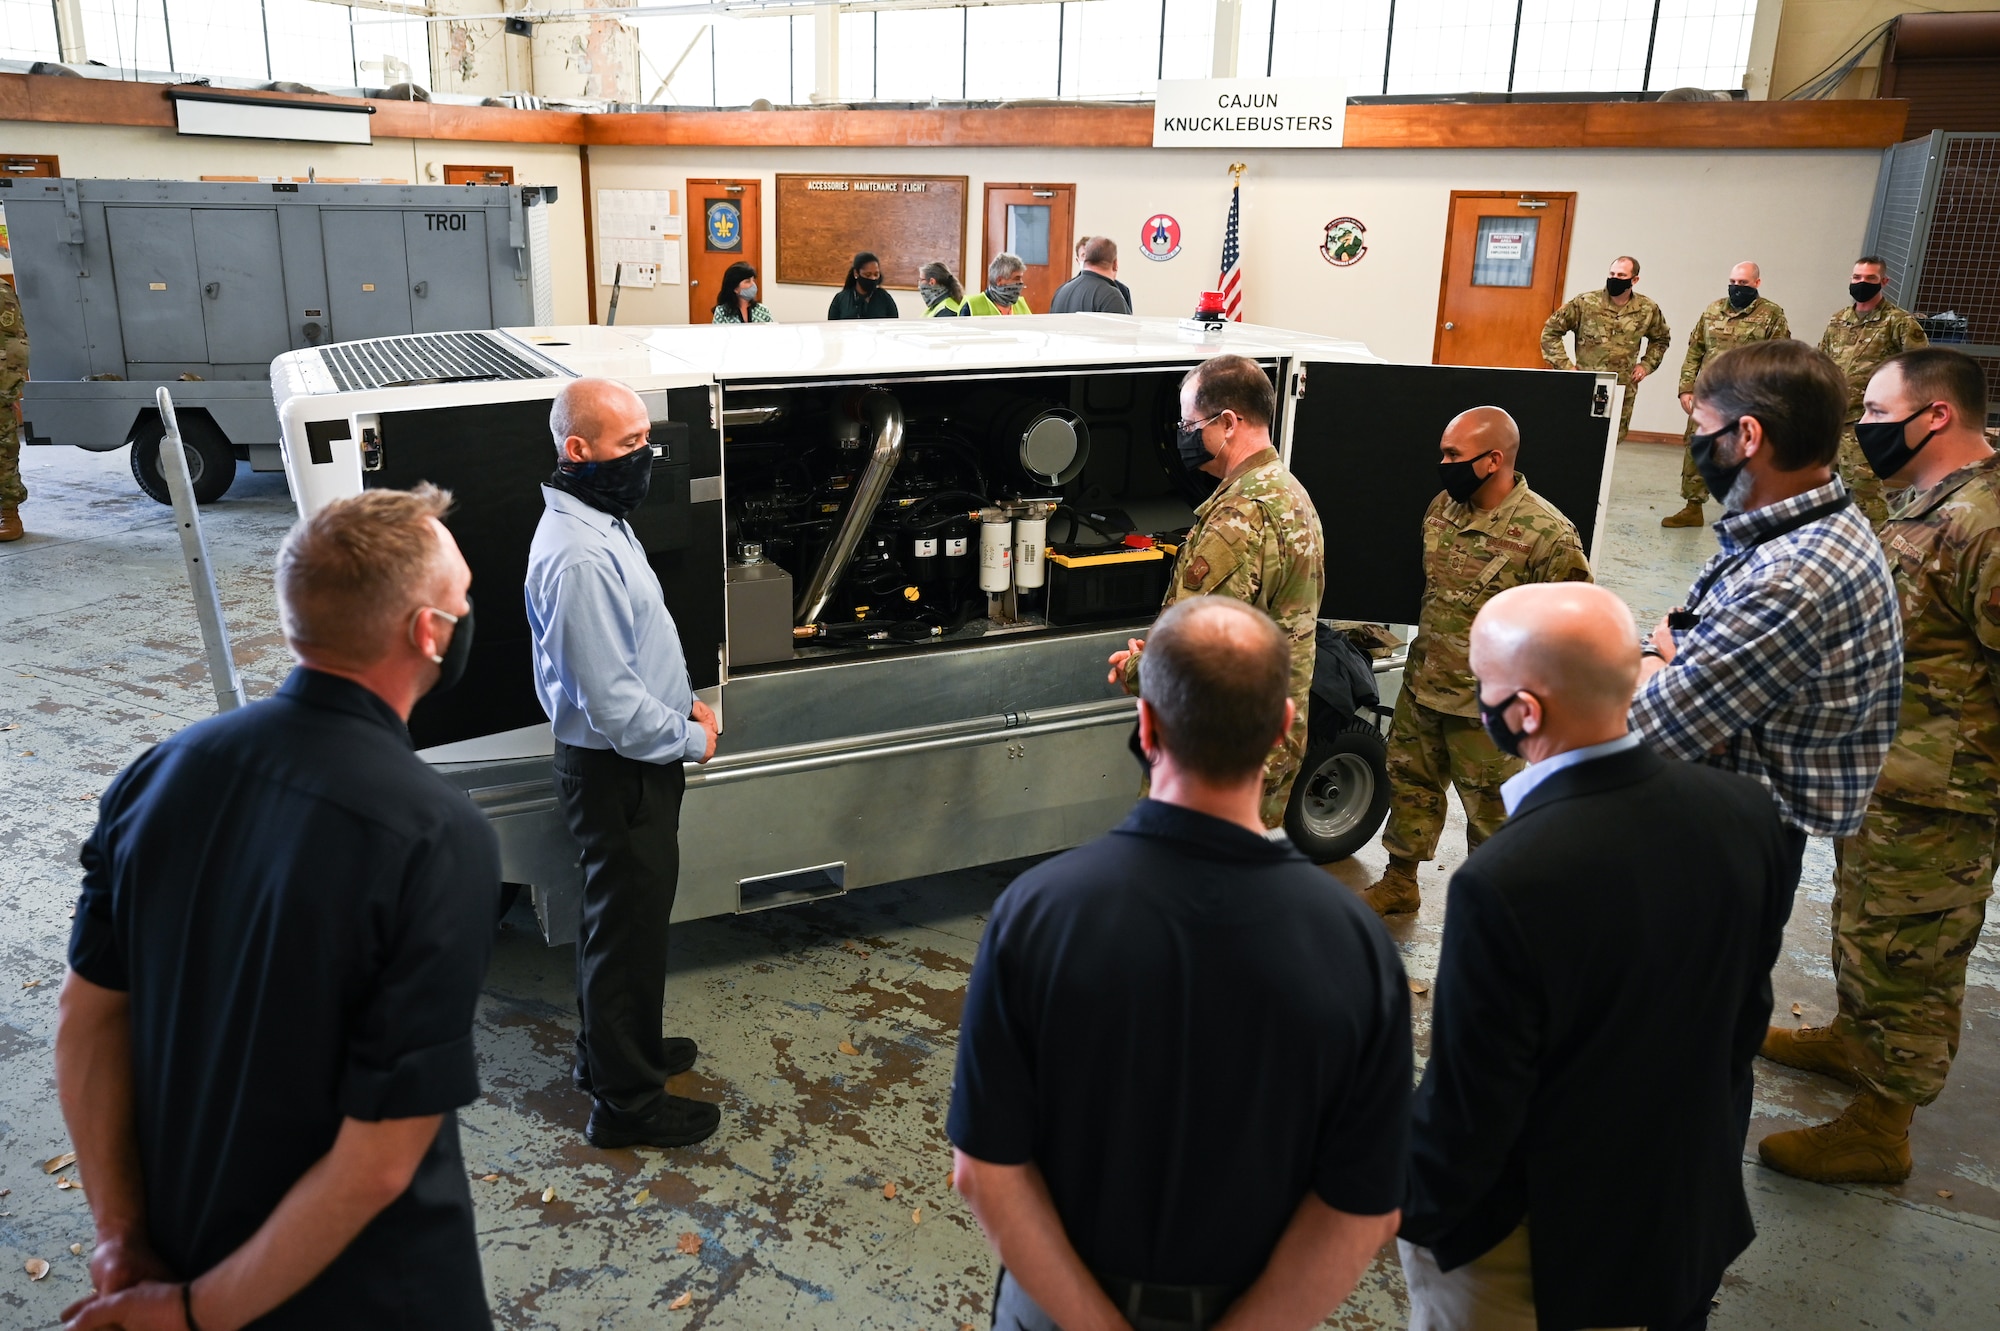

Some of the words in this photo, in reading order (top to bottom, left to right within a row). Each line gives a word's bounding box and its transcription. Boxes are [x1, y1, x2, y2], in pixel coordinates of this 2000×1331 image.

[1218, 93, 1278, 109] CAJUN
[1164, 116, 1333, 132] KNUCKLEBUSTERS
[808, 182, 849, 191] ACCESSORIES
[854, 182, 898, 192] MAINTENANCE
[902, 183, 926, 193] FLIGHT
